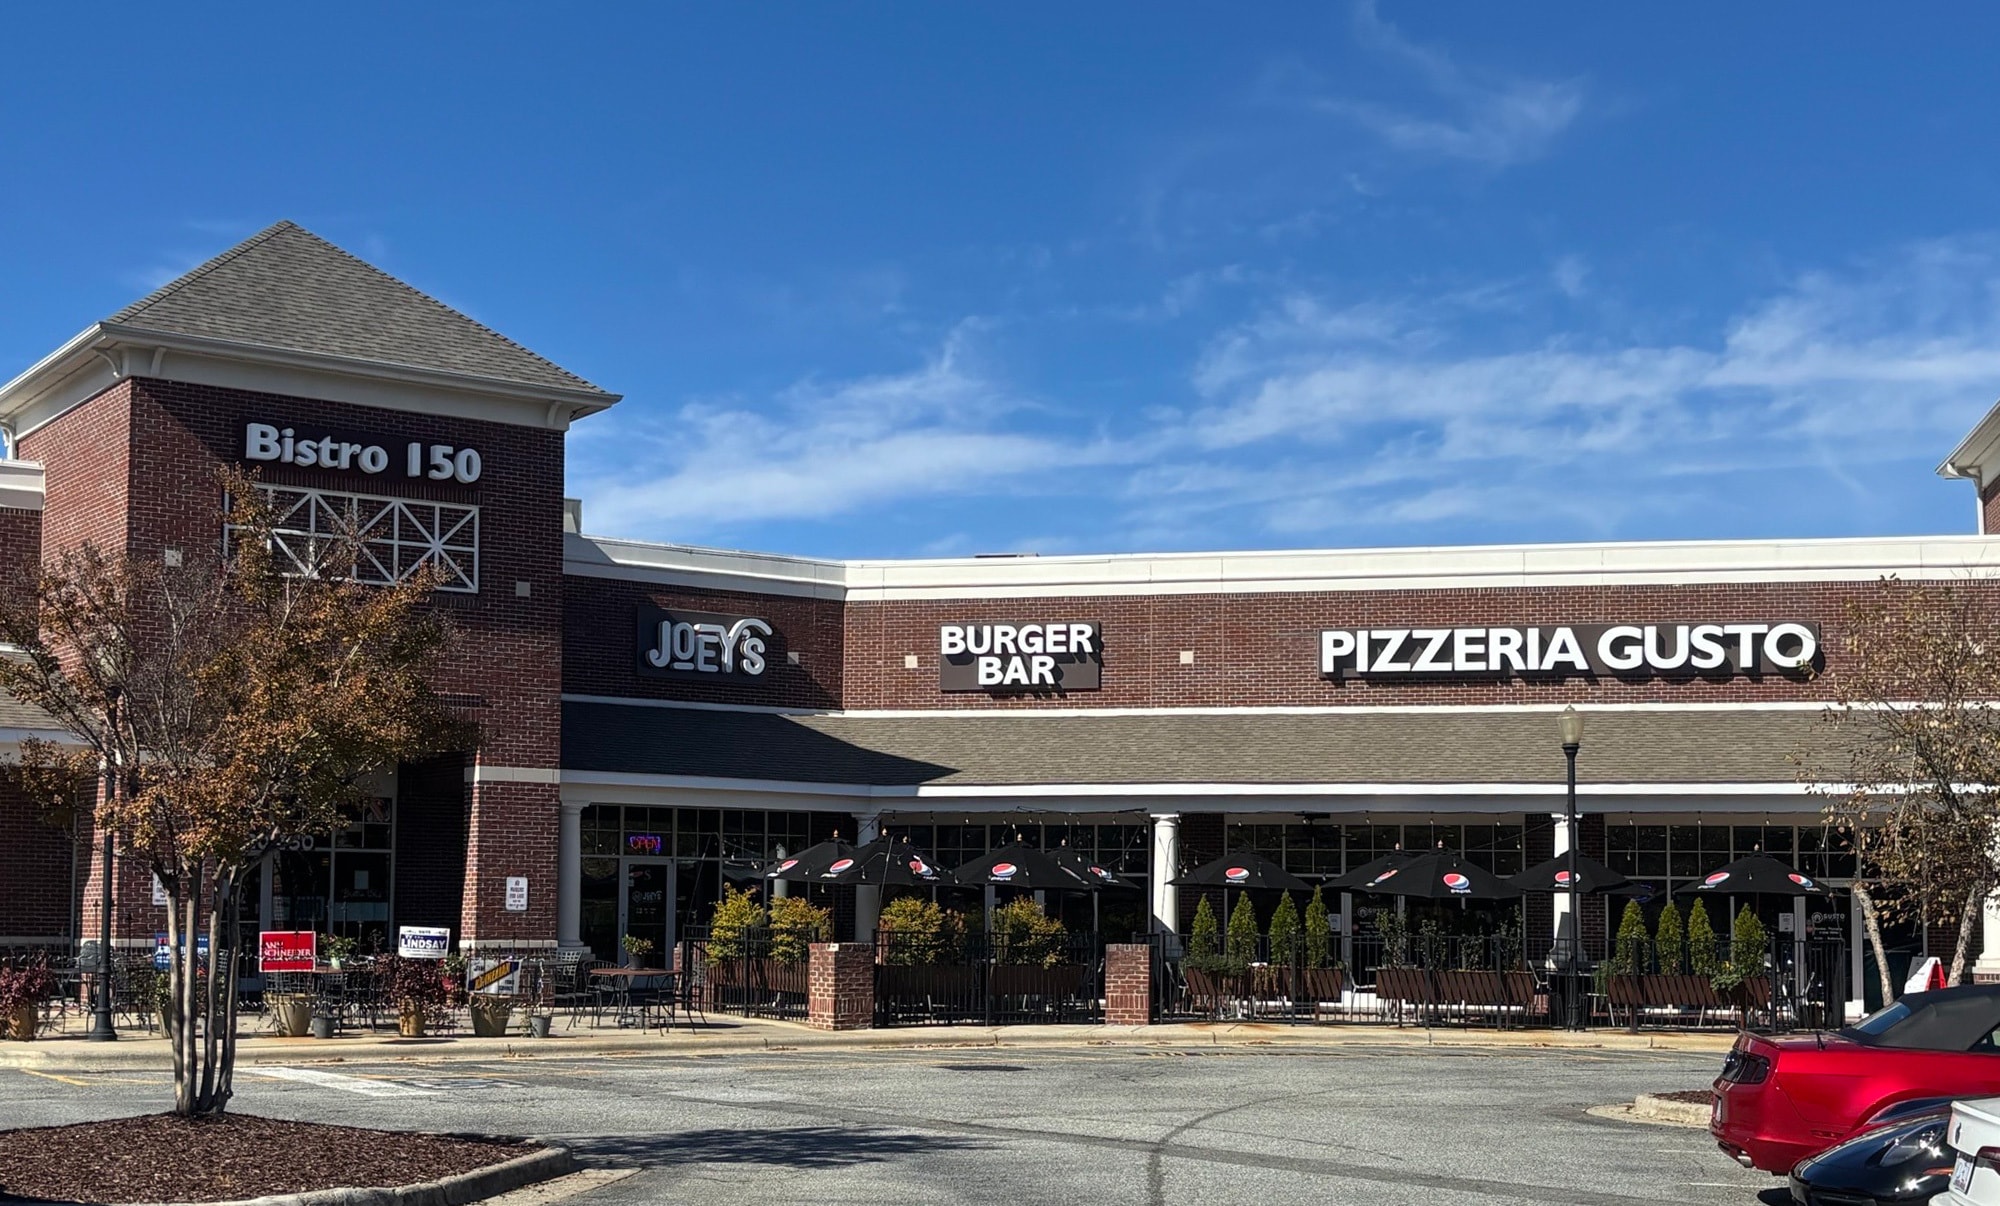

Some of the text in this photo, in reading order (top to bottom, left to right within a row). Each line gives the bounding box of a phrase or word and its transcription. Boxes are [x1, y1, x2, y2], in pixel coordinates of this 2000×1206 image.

[245, 423, 482, 484] Bistro 150
[649, 618, 773, 675] JOEY'S
[940, 623, 1093, 655] BURGER
[1320, 623, 1816, 673] PIZZERIA GUSTO
[978, 655, 1055, 686] BAR
[630, 836, 659, 850] OPEN
[401, 938, 446, 949] LINDSAY
